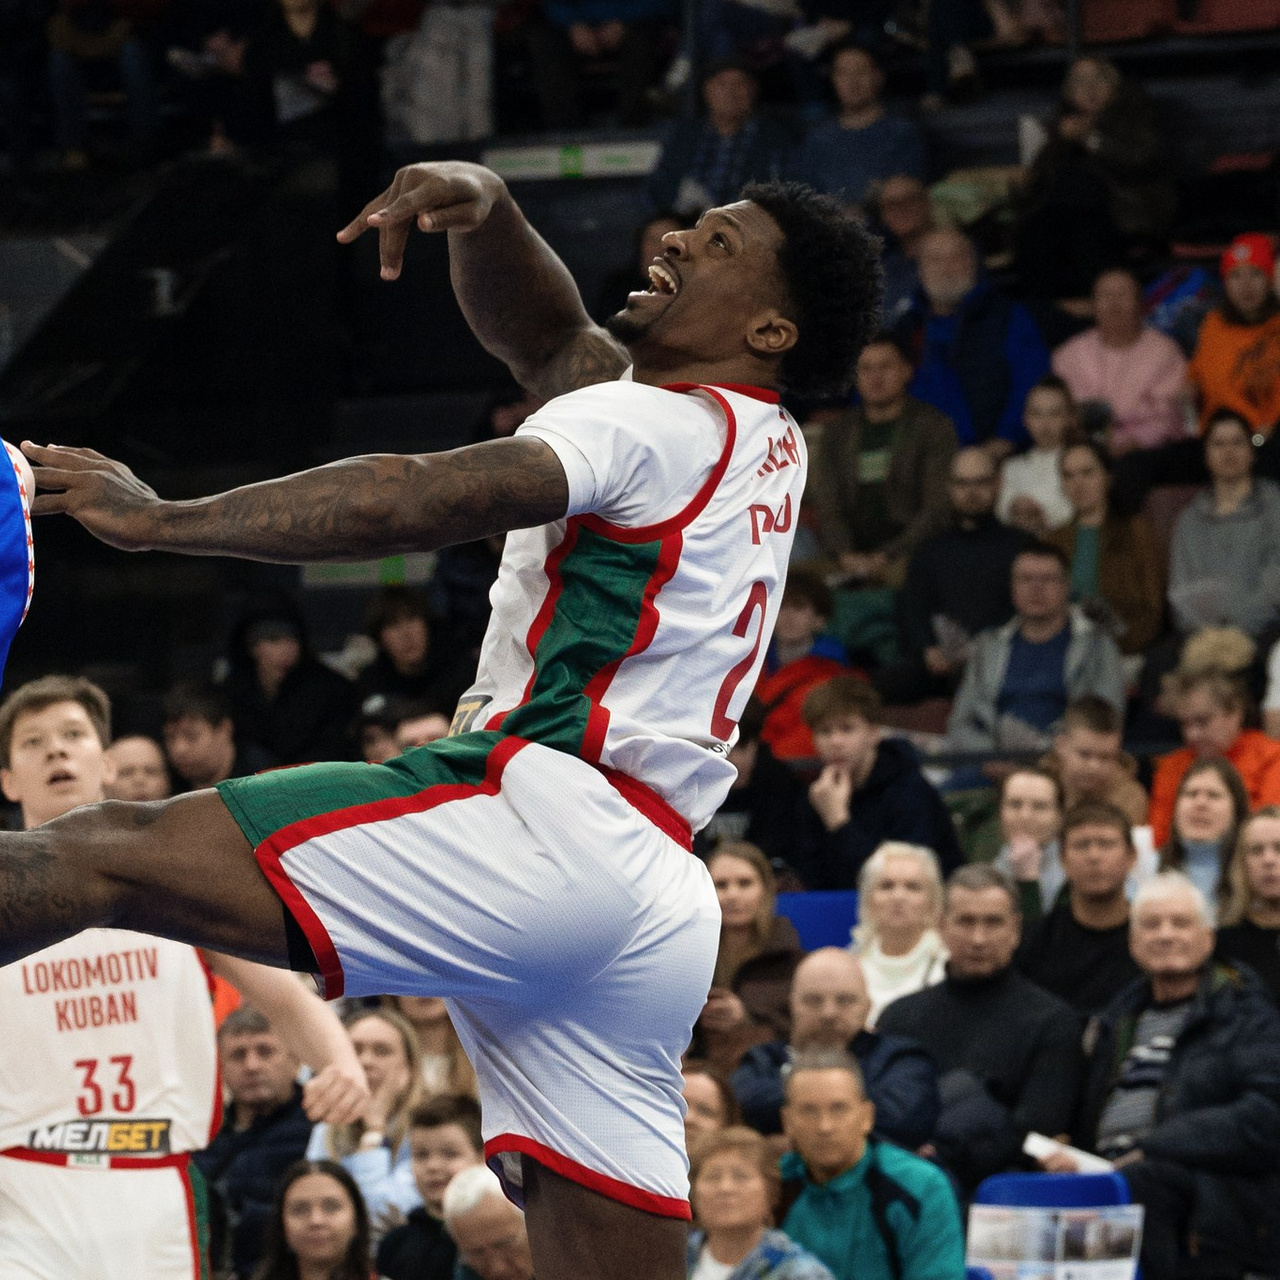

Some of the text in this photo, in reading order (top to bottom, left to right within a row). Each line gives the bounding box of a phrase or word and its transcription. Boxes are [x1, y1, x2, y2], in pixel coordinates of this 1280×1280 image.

[21, 947, 158, 995] LOKOMOTIV
[54, 992, 138, 1033] KUBAN
[74, 1055, 136, 1116] 33
